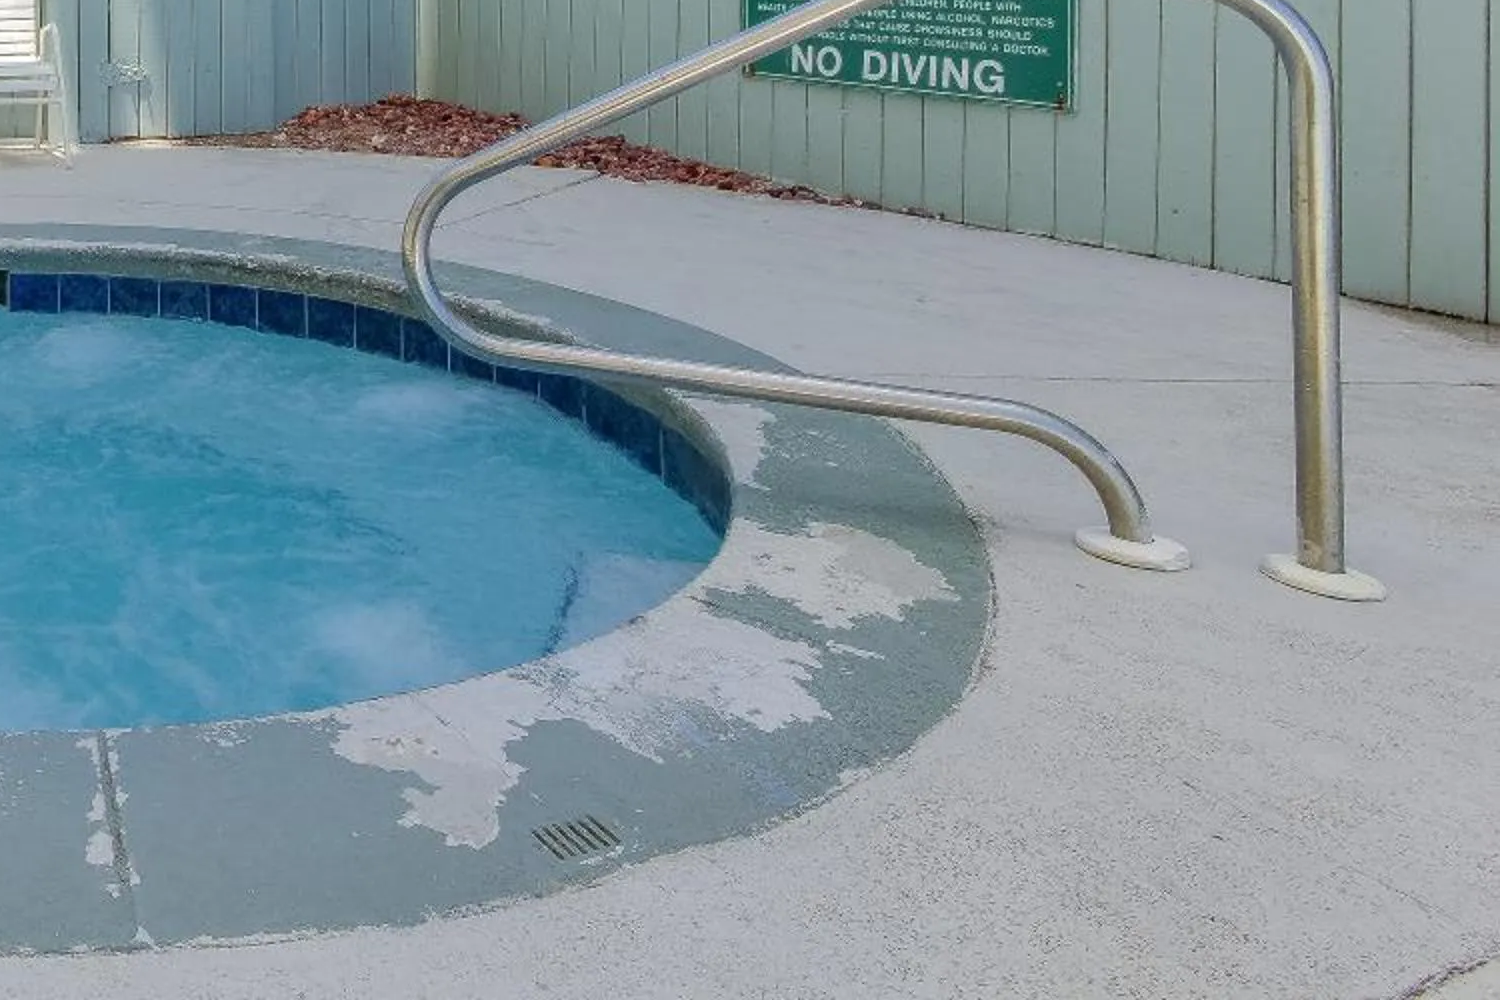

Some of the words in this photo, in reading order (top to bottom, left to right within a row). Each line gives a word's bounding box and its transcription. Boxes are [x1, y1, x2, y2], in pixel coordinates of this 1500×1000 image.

[953, 0, 992, 11] PEOPLE
[995, 1, 1021, 12] WITH
[991, 15, 1056, 28] NARCOTICS
[915, 24, 982, 37] DROWSINESS
[987, 29, 1033, 41] SHOULD
[923, 37, 987, 51] CONSULTING
[790, 44, 843, 76] NO
[862, 52, 1005, 94] DIVING
